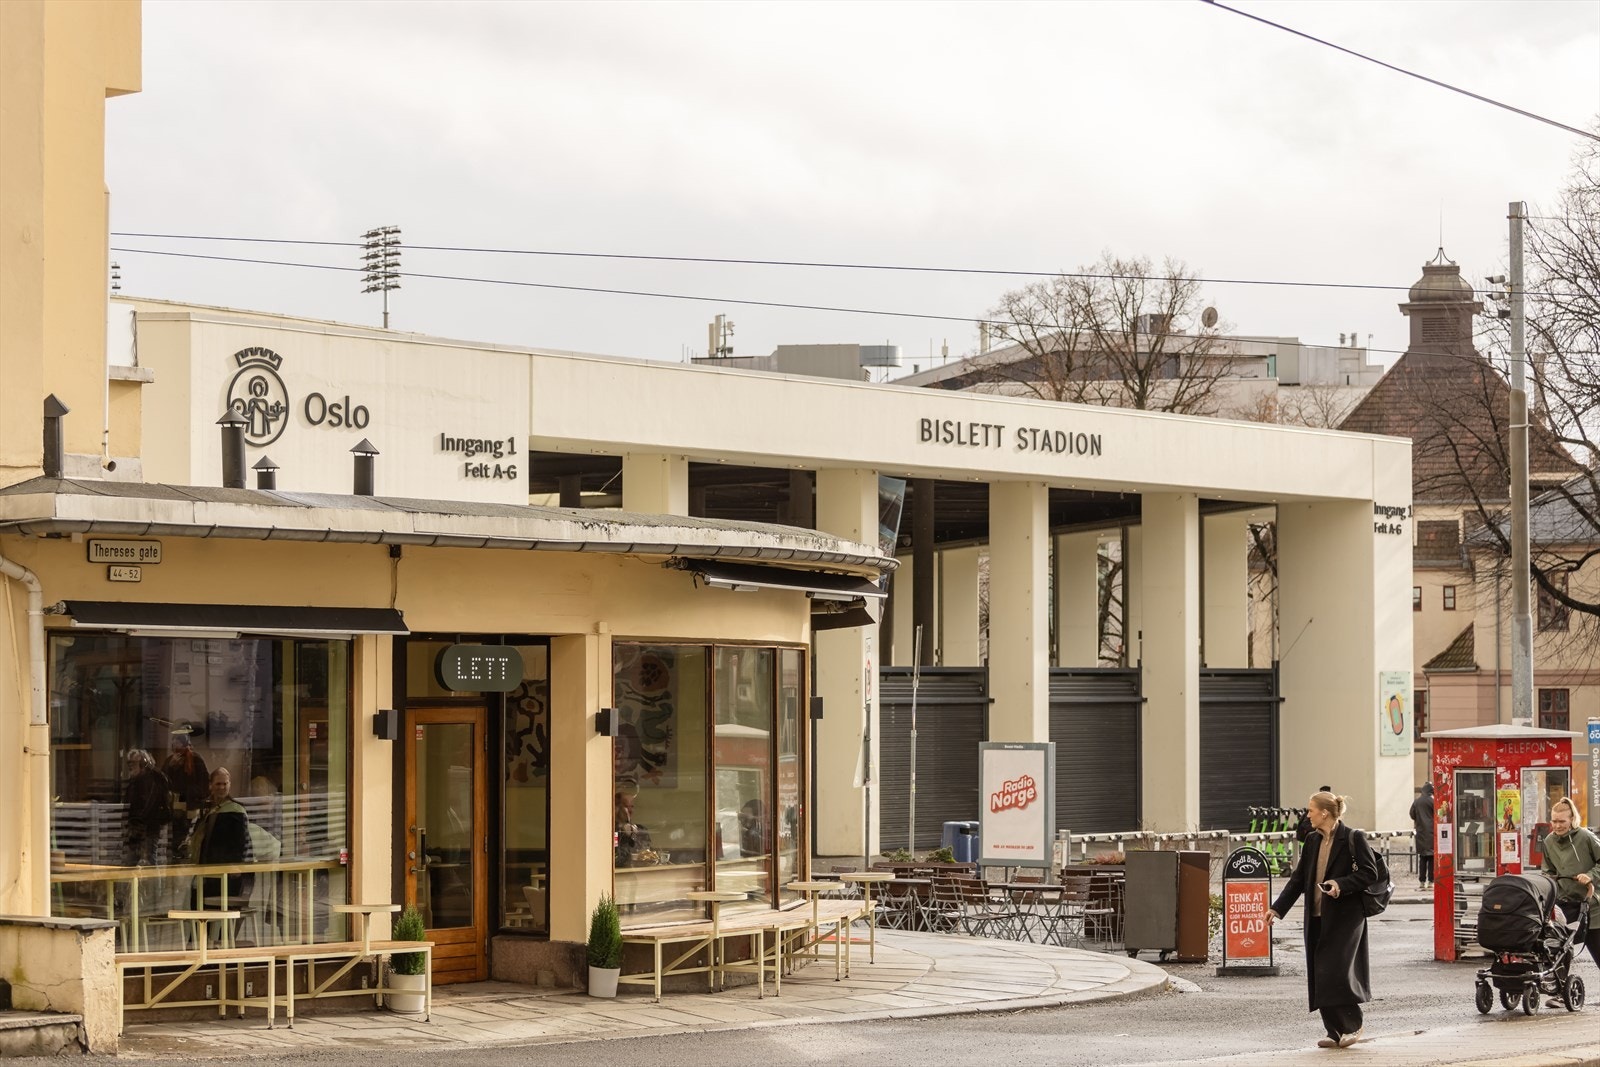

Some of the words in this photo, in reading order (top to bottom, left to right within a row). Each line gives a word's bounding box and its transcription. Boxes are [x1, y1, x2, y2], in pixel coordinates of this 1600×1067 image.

[305, 392, 370, 430] Oslo
[441, 432, 504, 459] Inngang
[507, 436, 517, 455] 1
[920, 417, 1005, 448] BISLETT
[1017, 426, 1102, 456] STADION
[465, 462, 490, 478] Felt
[493, 463, 517, 480] A-G
[1374, 501, 1406, 521] Inngang
[1407, 504, 1413, 518] 1
[1374, 522, 1387, 534] Felt
[1388, 523, 1402, 535] A-G
[94, 543, 135, 558] Thereses
[139, 545, 158, 561] gate
[457, 656, 509, 680] LETT
[1503, 741, 1547, 755] TELEFON
[1592, 747, 1600, 767] Oslo
[1004, 775, 1034, 794] Radio
[1592, 769, 1600, 807] Bysykkel
[992, 786, 1035, 811] Norge
[1229, 893, 1251, 903] TENK
[1253, 892, 1264, 902] AT
[1229, 902, 1264, 914] SURDEIG
[1230, 919, 1264, 934] GLAD
